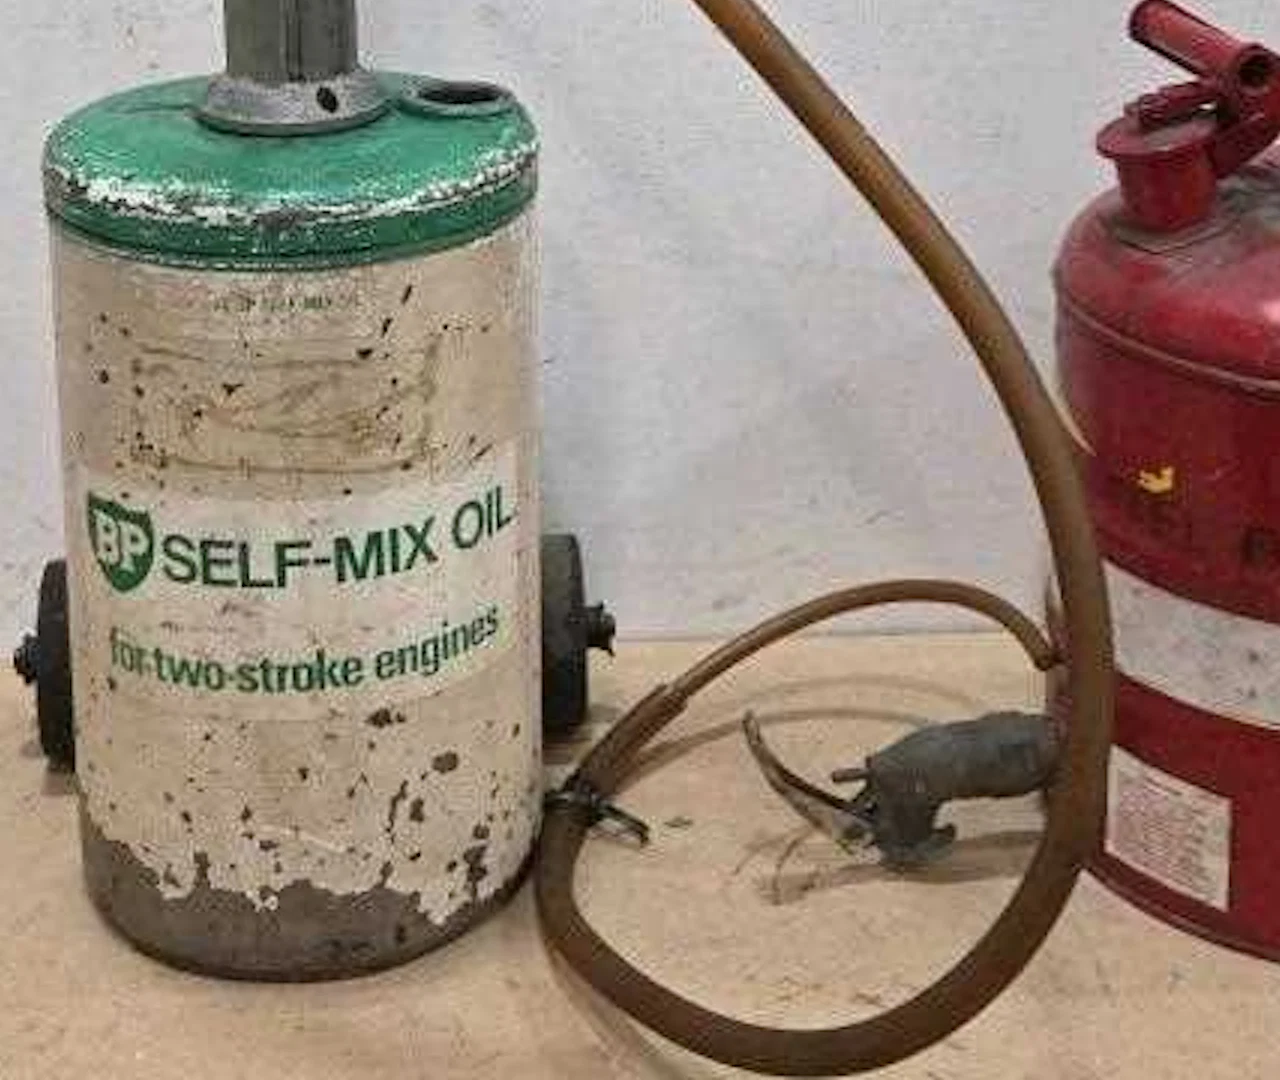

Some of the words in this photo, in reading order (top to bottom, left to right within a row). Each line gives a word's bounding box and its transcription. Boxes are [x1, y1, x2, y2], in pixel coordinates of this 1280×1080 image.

[91, 506, 152, 574] BP
[162, 517, 438, 588] SELF-MIX
[110, 626, 148, 676] for
[375, 606, 500, 678] engines
